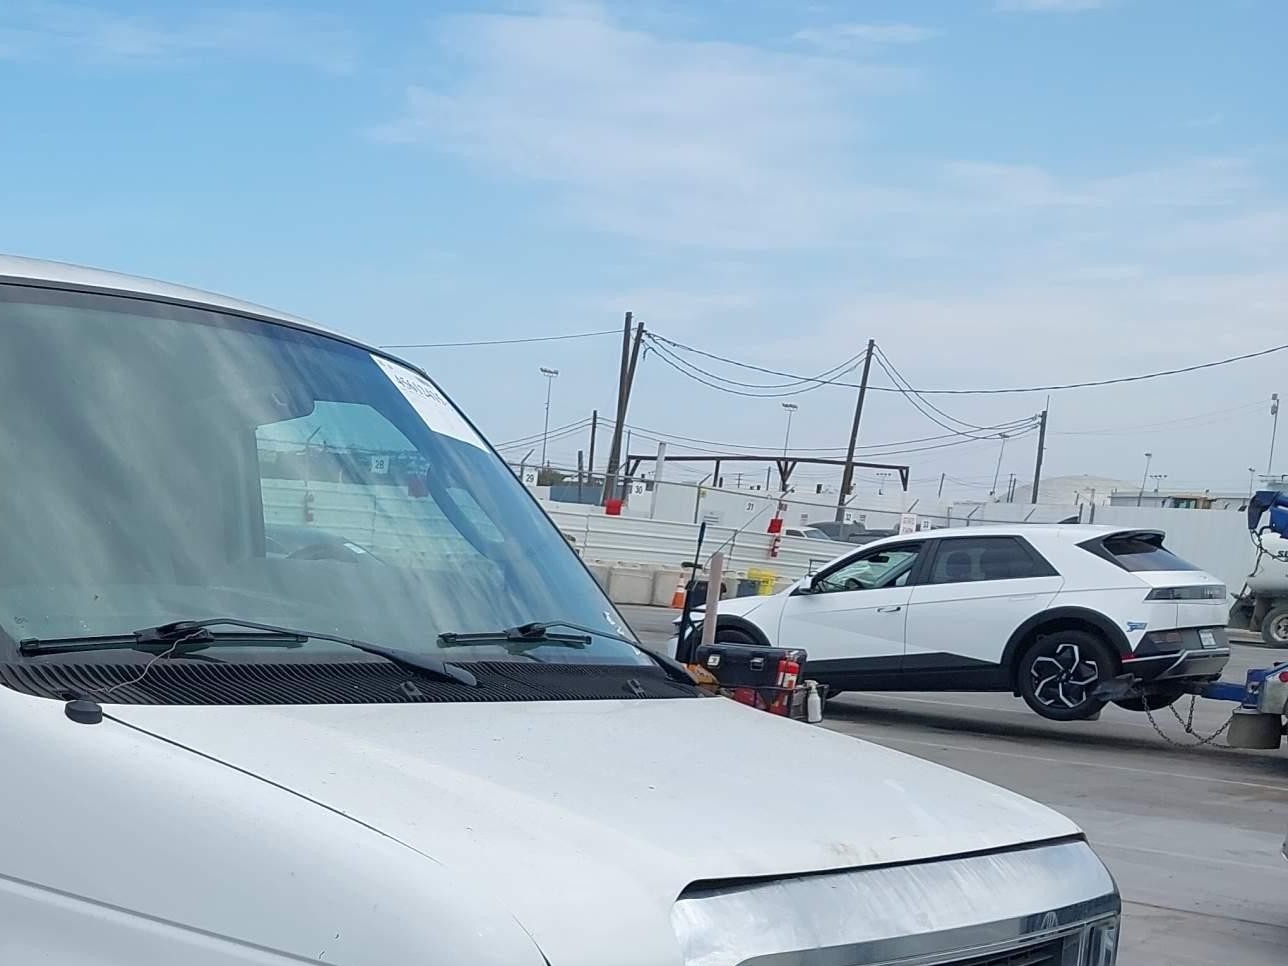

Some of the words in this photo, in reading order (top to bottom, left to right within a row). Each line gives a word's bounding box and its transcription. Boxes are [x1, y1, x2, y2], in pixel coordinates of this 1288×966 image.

[374, 459, 385, 469] 28
[526, 473, 535, 482] 29
[635, 485, 643, 494] 30
[746, 502, 754, 511] 31
